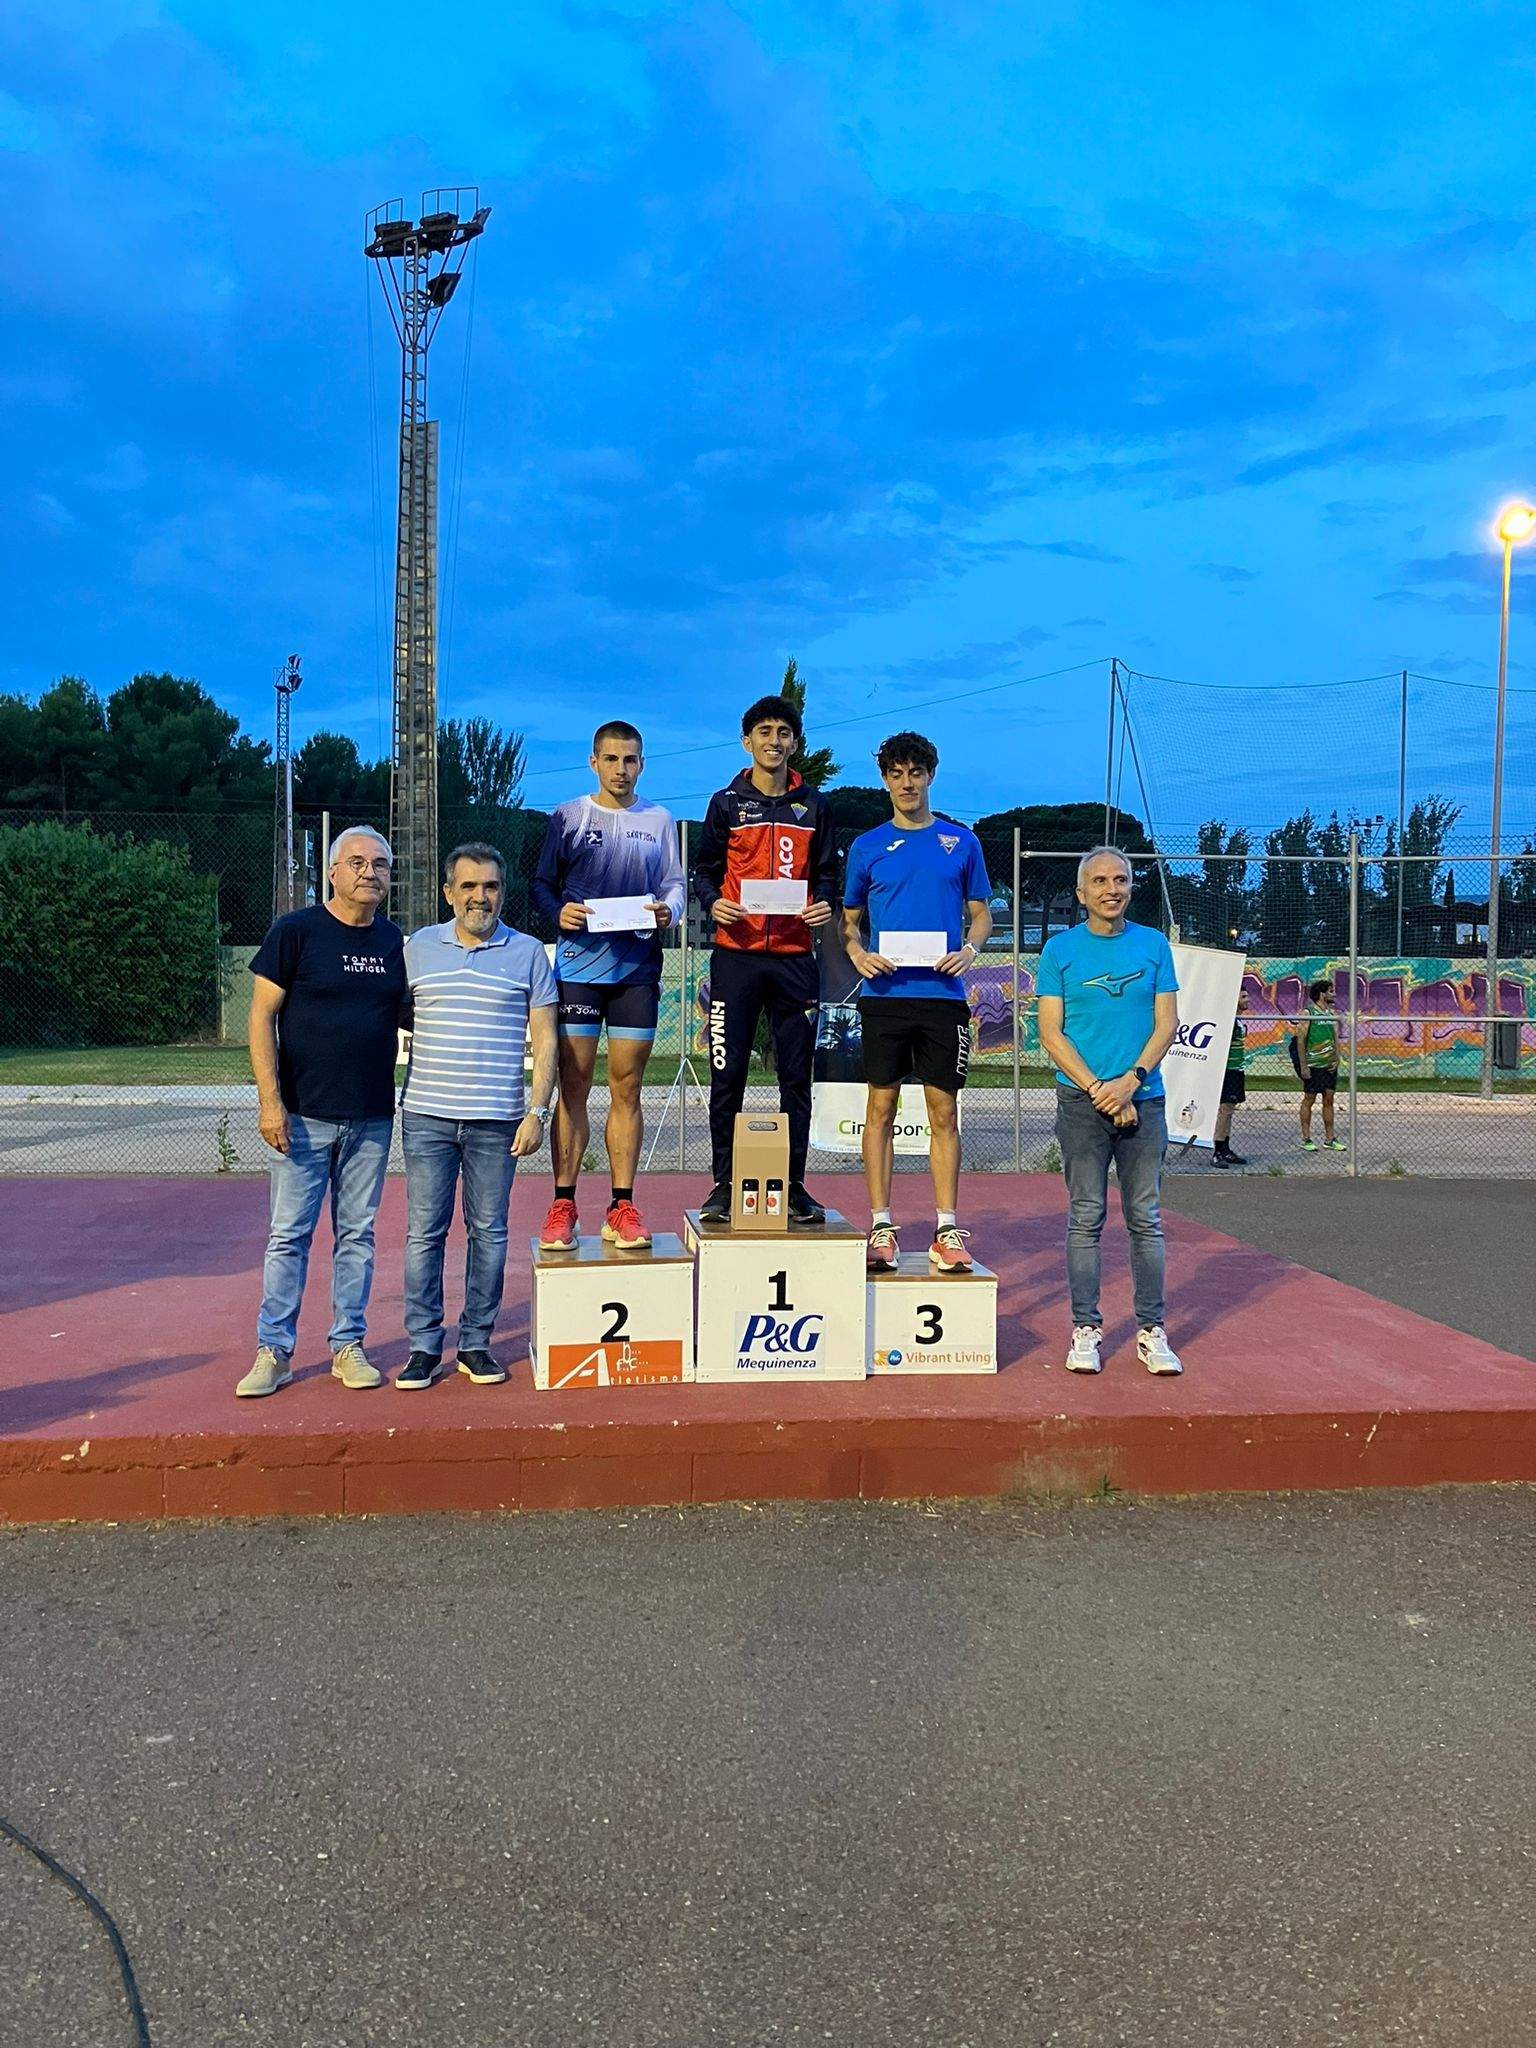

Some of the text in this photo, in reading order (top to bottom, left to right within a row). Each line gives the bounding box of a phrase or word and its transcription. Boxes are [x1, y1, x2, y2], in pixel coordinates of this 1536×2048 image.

[778, 836, 794, 880] ACO
[342, 955, 384, 964] TOMMY
[343, 965, 387, 973] HILFIGER
[576, 1007, 600, 1016] JOAN
[710, 1000, 726, 1070] HINACO
[1174, 1021, 1217, 1049] &G
[1168, 1049, 1208, 1061] uinenza
[768, 1271, 793, 1311] 1
[600, 1302, 630, 1343] 2
[739, 1314, 824, 1353] P&G
[915, 1304, 944, 1345] 3
[736, 1357, 817, 1371] Mequinenza
[906, 1352, 991, 1366] Vibrant Living
